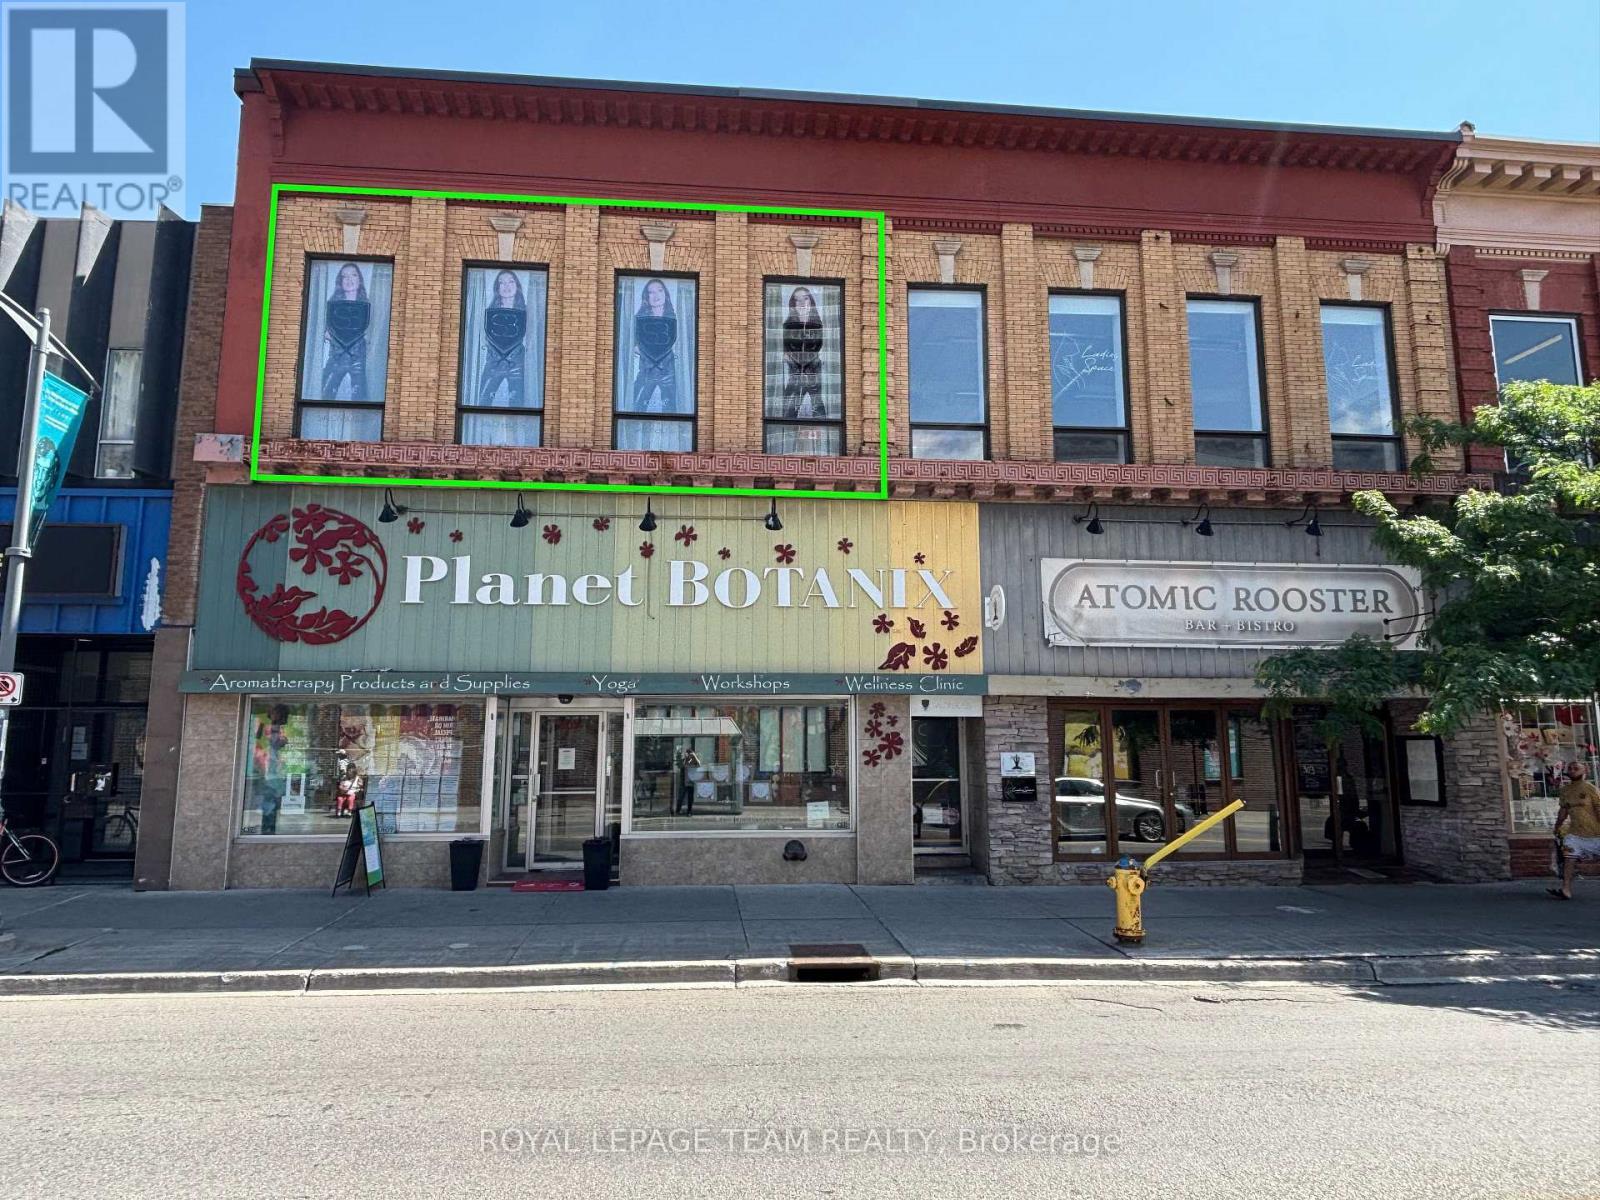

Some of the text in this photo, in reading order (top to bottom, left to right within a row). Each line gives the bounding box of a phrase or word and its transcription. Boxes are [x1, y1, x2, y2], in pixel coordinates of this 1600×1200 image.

[399, 555, 958, 609] Planet BOTANIX
[1075, 584, 1393, 614] ATOMIC ROOSTER
[1185, 619, 1217, 631] BAR
[1237, 620, 1295, 632] BISTRO
[209, 674, 334, 694] Aromatherapy
[340, 674, 415, 691] Products
[454, 674, 531, 693] Supplies
[591, 674, 638, 693] Yoga
[701, 674, 790, 693] Workshops
[845, 674, 964, 693] Wellness Clinic
